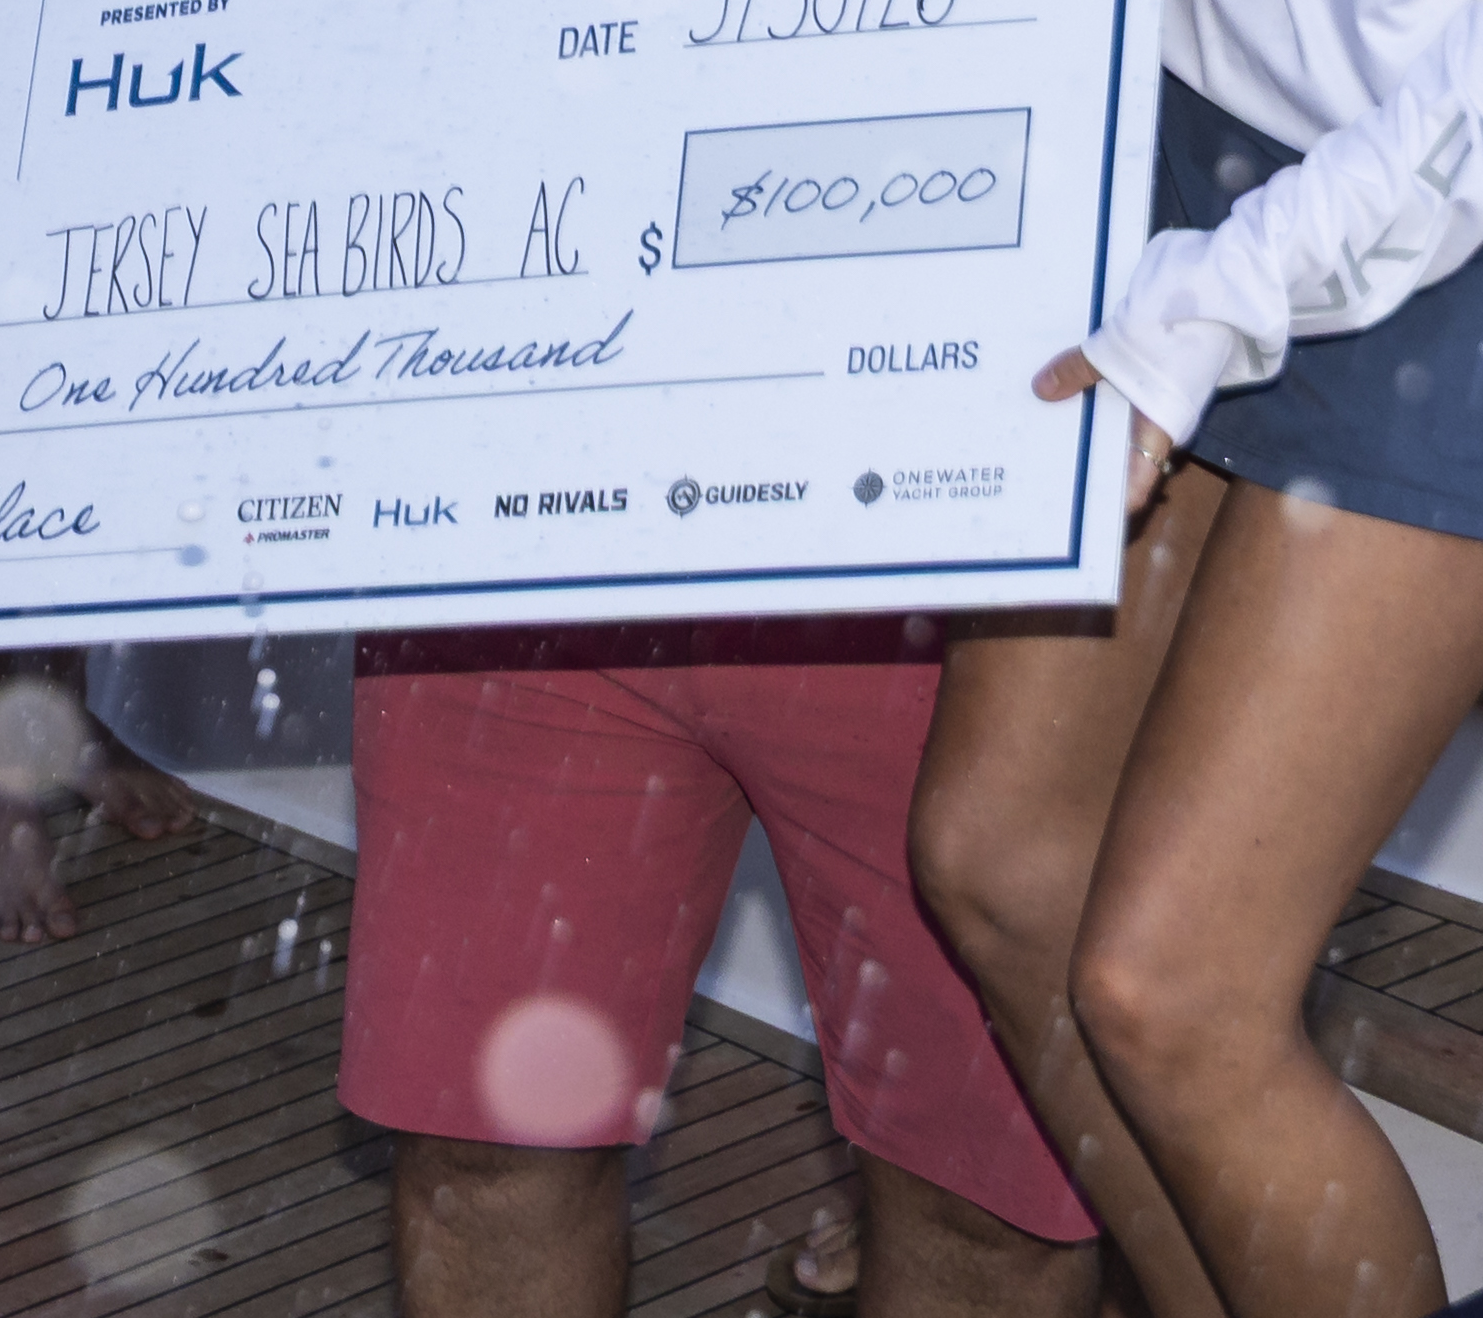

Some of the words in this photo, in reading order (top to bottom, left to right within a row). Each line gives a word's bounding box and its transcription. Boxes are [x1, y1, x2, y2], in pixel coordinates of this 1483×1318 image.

[101, 0, 201, 26] PRESENTED
[559, 21, 637, 60] DATE
[722, 166, 997, 231] $100,000
[43, 207, 207, 322] JERSEY
[249, 201, 319, 300] SEA
[340, 185, 465, 297] BIRDS
[521, 177, 585, 278] AC
[639, 221, 663, 276] $
[19, 362, 116, 415] One
[129, 330, 370, 413] Hundred
[374, 309, 634, 381] Thousand
[847, 341, 979, 375] DOLLARS
[893, 467, 1005, 486] ONEWATER
[237, 493, 343, 523] CITIZEN
[494, 494, 529, 518] NO
[538, 487, 628, 516] RIVALS
[705, 480, 809, 505] GUIDESLY
[893, 486, 941, 501] YACHT
[947, 484, 1003, 499] GROUP
[257, 528, 330, 543] PROMASTER
